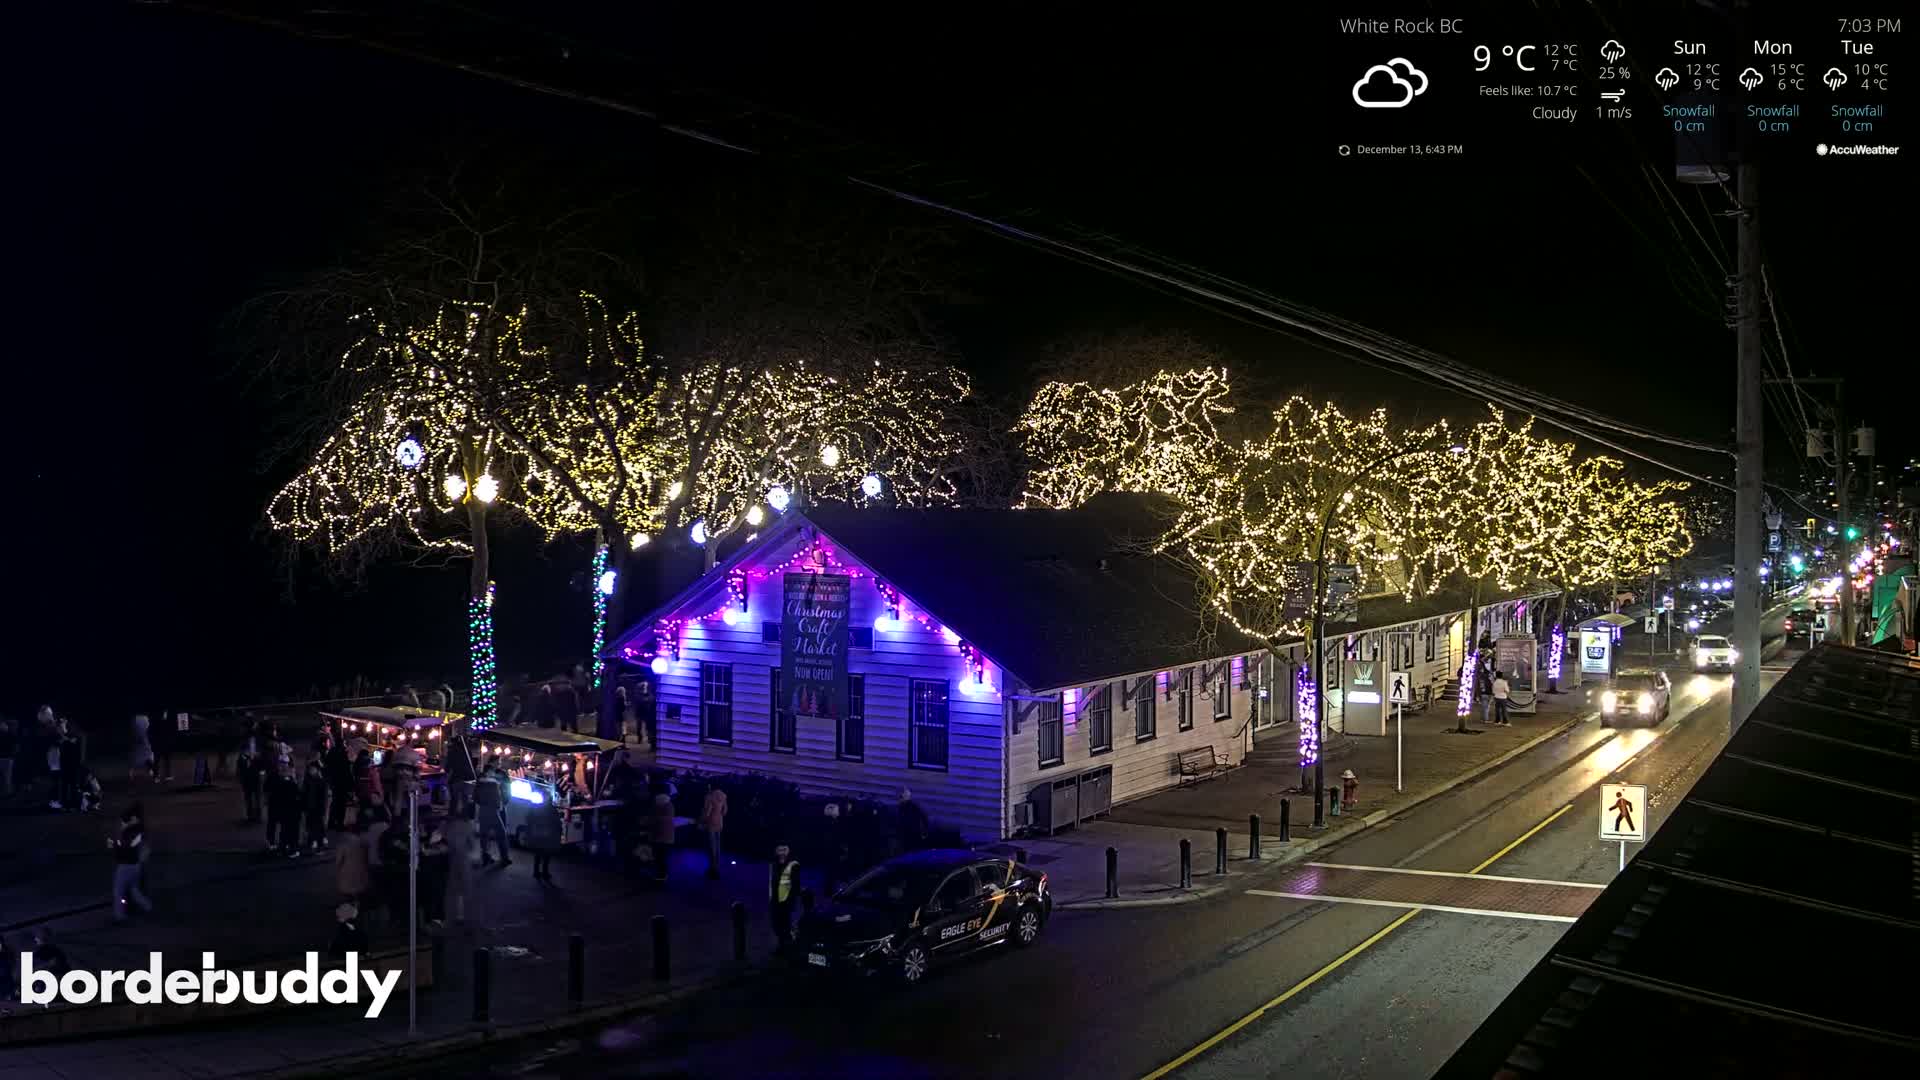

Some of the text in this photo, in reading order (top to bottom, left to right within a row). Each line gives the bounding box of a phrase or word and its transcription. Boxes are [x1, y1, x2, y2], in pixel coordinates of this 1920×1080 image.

[787, 600, 846, 619] Christmas
[798, 617, 831, 644] Craft
[791, 636, 837, 656] Market
[794, 666, 811, 680] NOW
[940, 917, 982, 940] EAGLE EYE
[979, 922, 1012, 940] SECURITY
